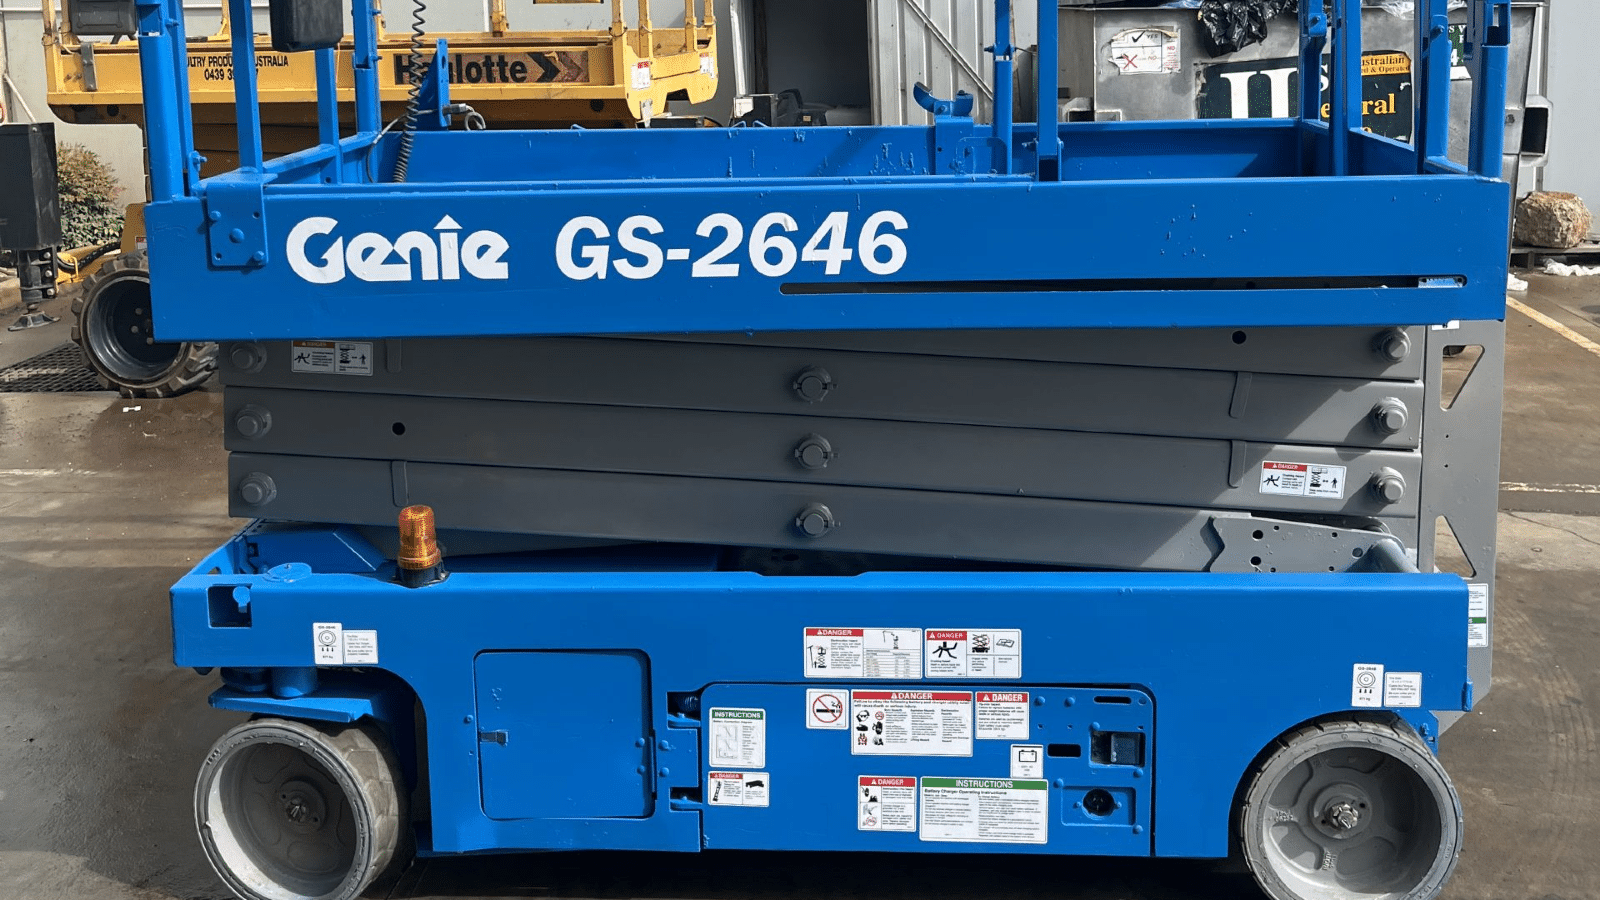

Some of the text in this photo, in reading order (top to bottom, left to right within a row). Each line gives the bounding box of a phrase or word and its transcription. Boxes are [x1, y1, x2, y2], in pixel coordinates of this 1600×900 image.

[204, 68, 225, 81] 0439
[286, 210, 908, 284] Genie GS-2646
[898, 692, 933, 700] DANGER
[992, 693, 1023, 702] DANGER
[877, 778, 904, 786] DANGER
[955, 779, 1014, 789] INSTRUCTIONS
